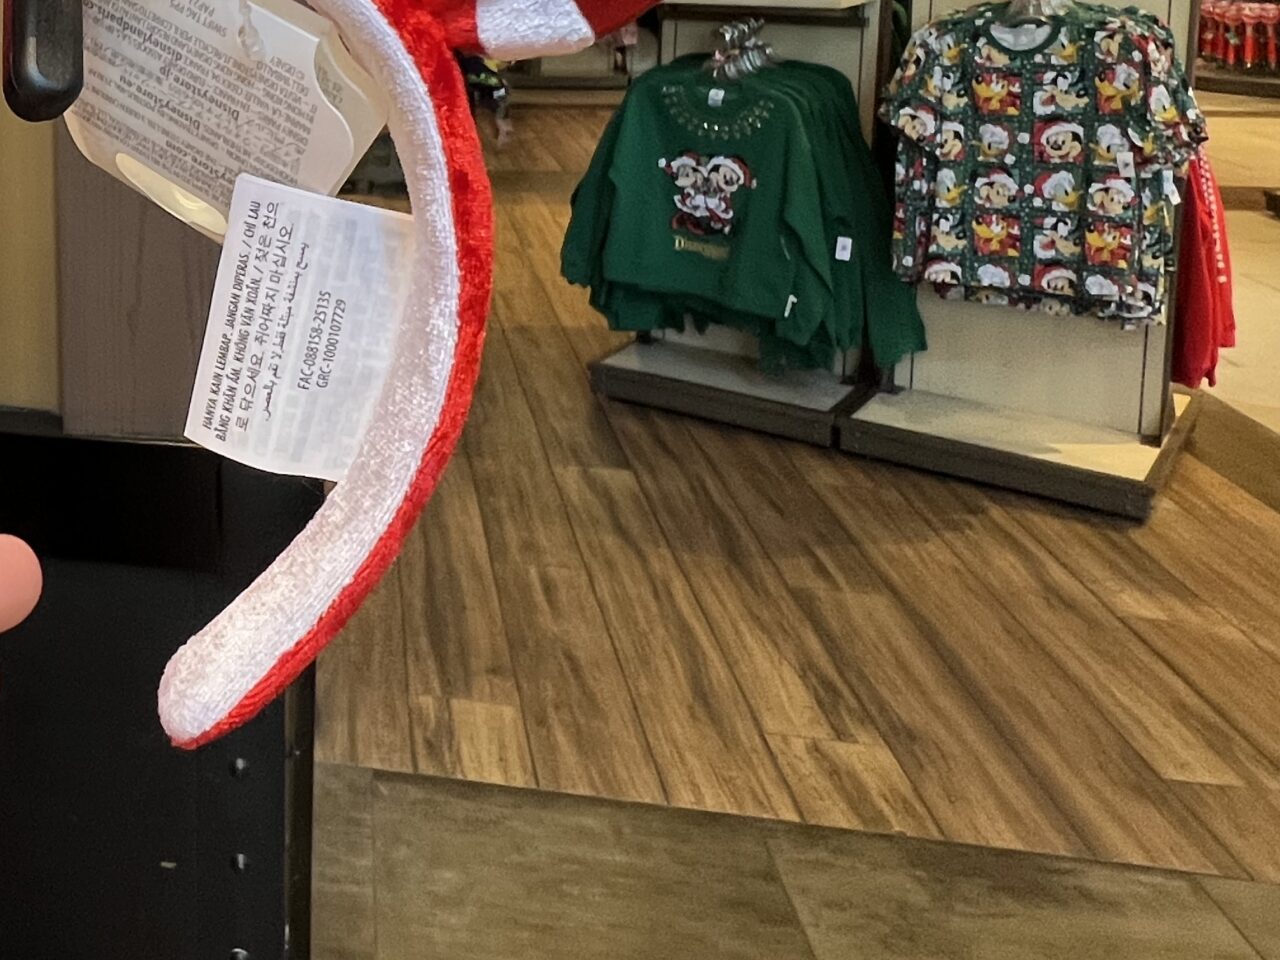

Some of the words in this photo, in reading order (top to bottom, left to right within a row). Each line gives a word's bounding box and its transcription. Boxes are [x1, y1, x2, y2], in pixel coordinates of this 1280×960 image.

[247, 200, 261, 219] LAU
[222, 292, 241, 329] JANGAN
[296, 289, 332, 390] FAC-088158-25135
[315, 297, 347, 389] GRC-1000107729
[208, 371, 223, 395] KAIN
[201, 397, 217, 429] HANYA
[234, 415, 249, 431] 로
